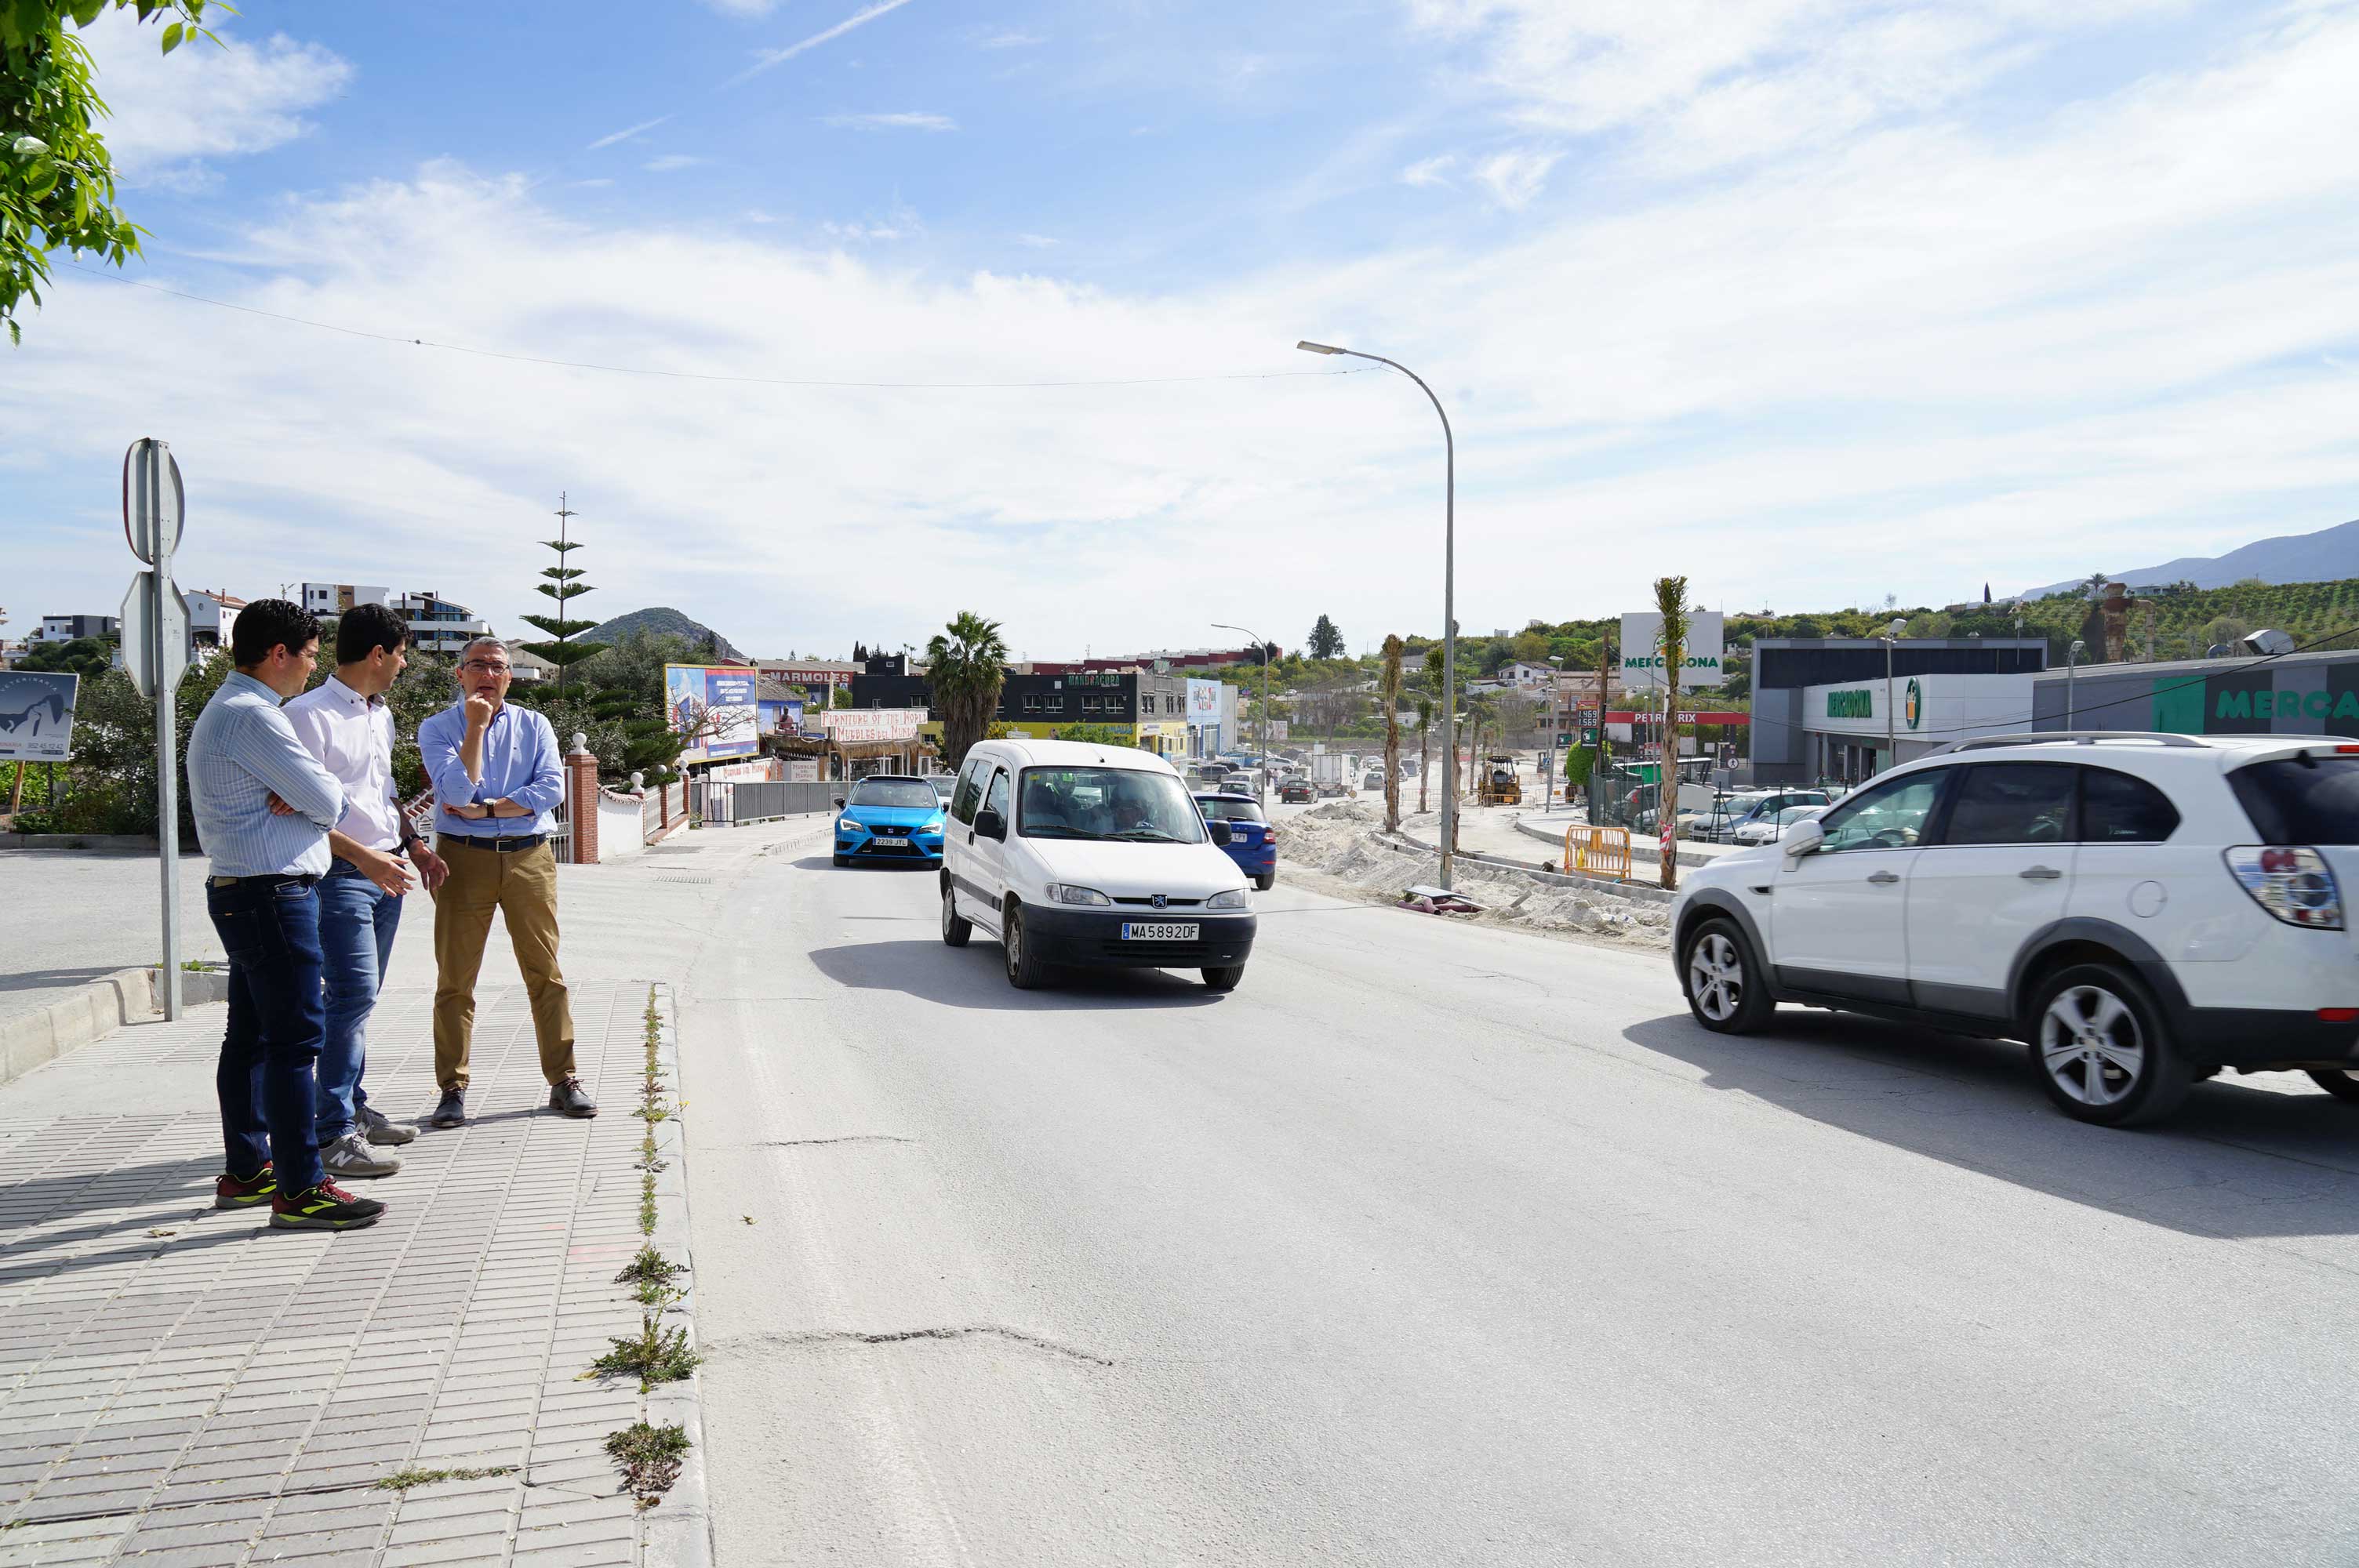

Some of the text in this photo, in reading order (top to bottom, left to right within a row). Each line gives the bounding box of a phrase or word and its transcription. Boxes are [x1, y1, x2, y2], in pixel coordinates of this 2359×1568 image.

[1624, 657, 1718, 668] MERCONA
[770, 672, 849, 683] MARMOLES
[2215, 690, 2359, 719] MERCA
[821, 712, 868, 726] FURNITURE
[903, 711, 927, 722] WORLD
[1634, 713, 1696, 723] PETRRIX
[837, 728, 875, 741] MUEBLES
[892, 726, 917, 739] MUNDO
[1131, 925, 1198, 938] MA5892DF
[329, 1150, 355, 1167] N
